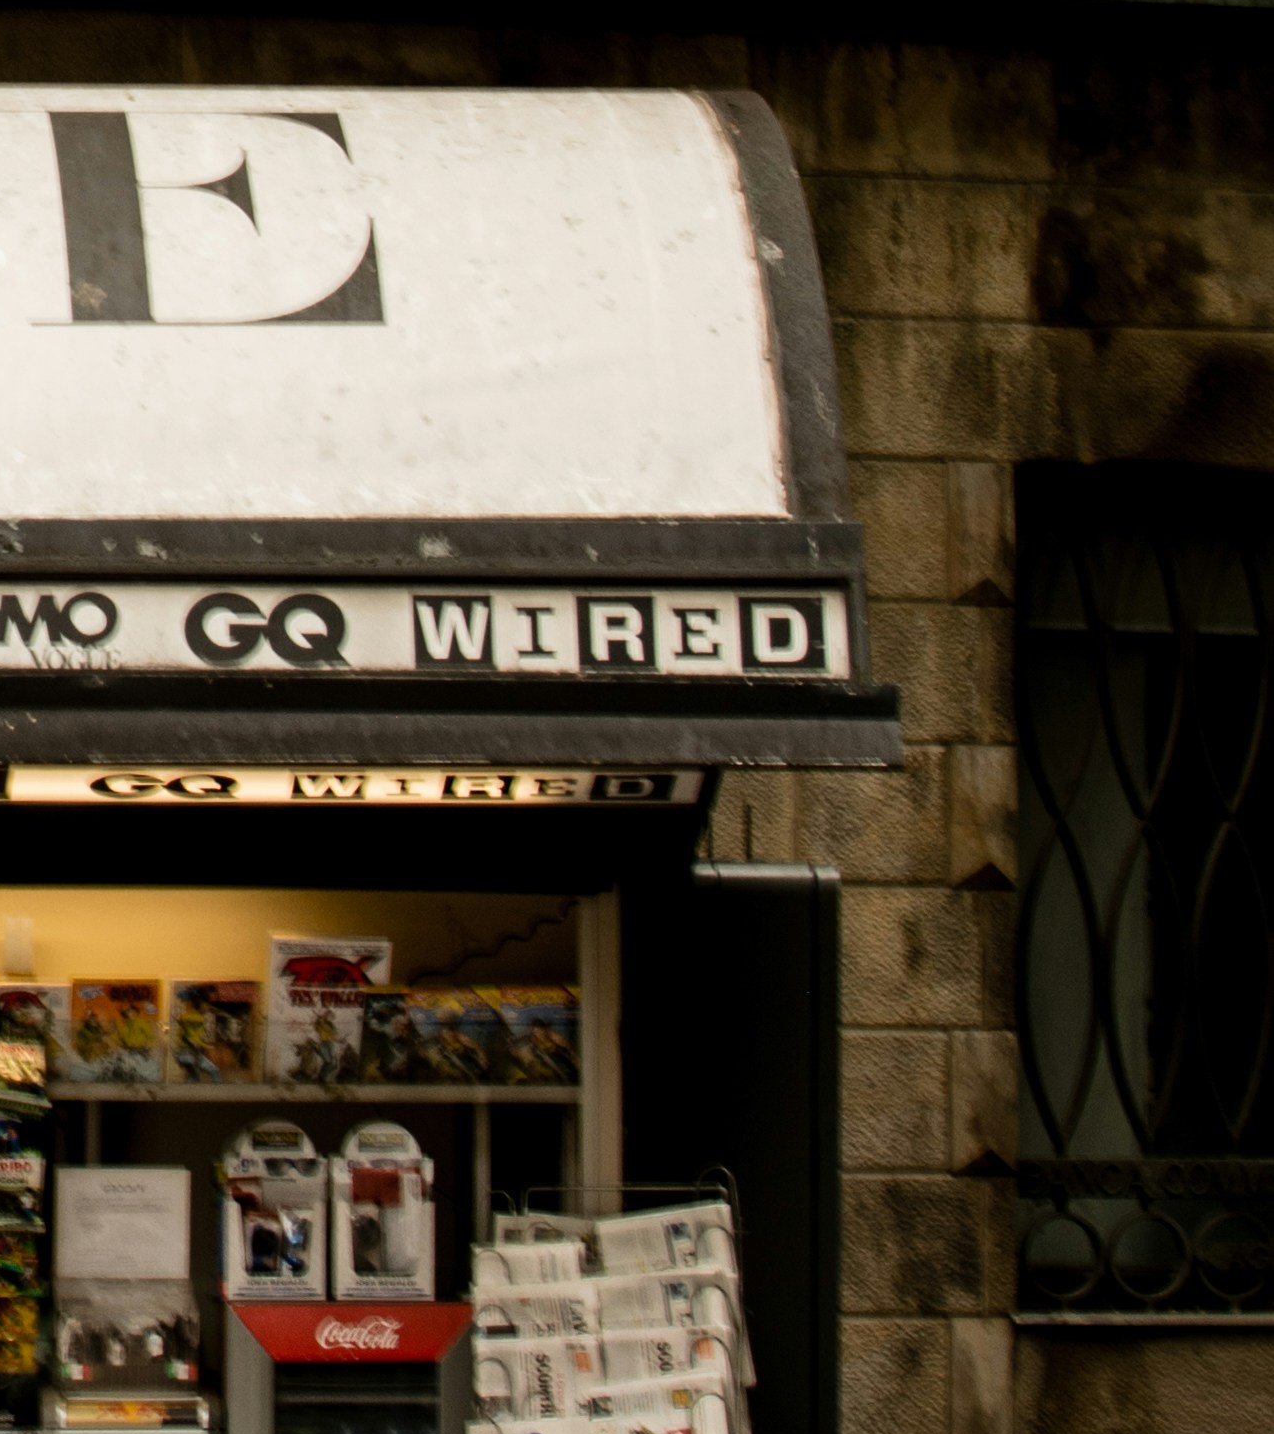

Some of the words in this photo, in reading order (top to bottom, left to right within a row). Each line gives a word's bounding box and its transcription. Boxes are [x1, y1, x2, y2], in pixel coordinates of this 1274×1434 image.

[185, 592, 351, 667] GQ
[414, 597, 815, 667] WIRED
[26, 646, 122, 671] VOGUE
[89, 772, 241, 800] GQ
[292, 773, 662, 802] WIRED
